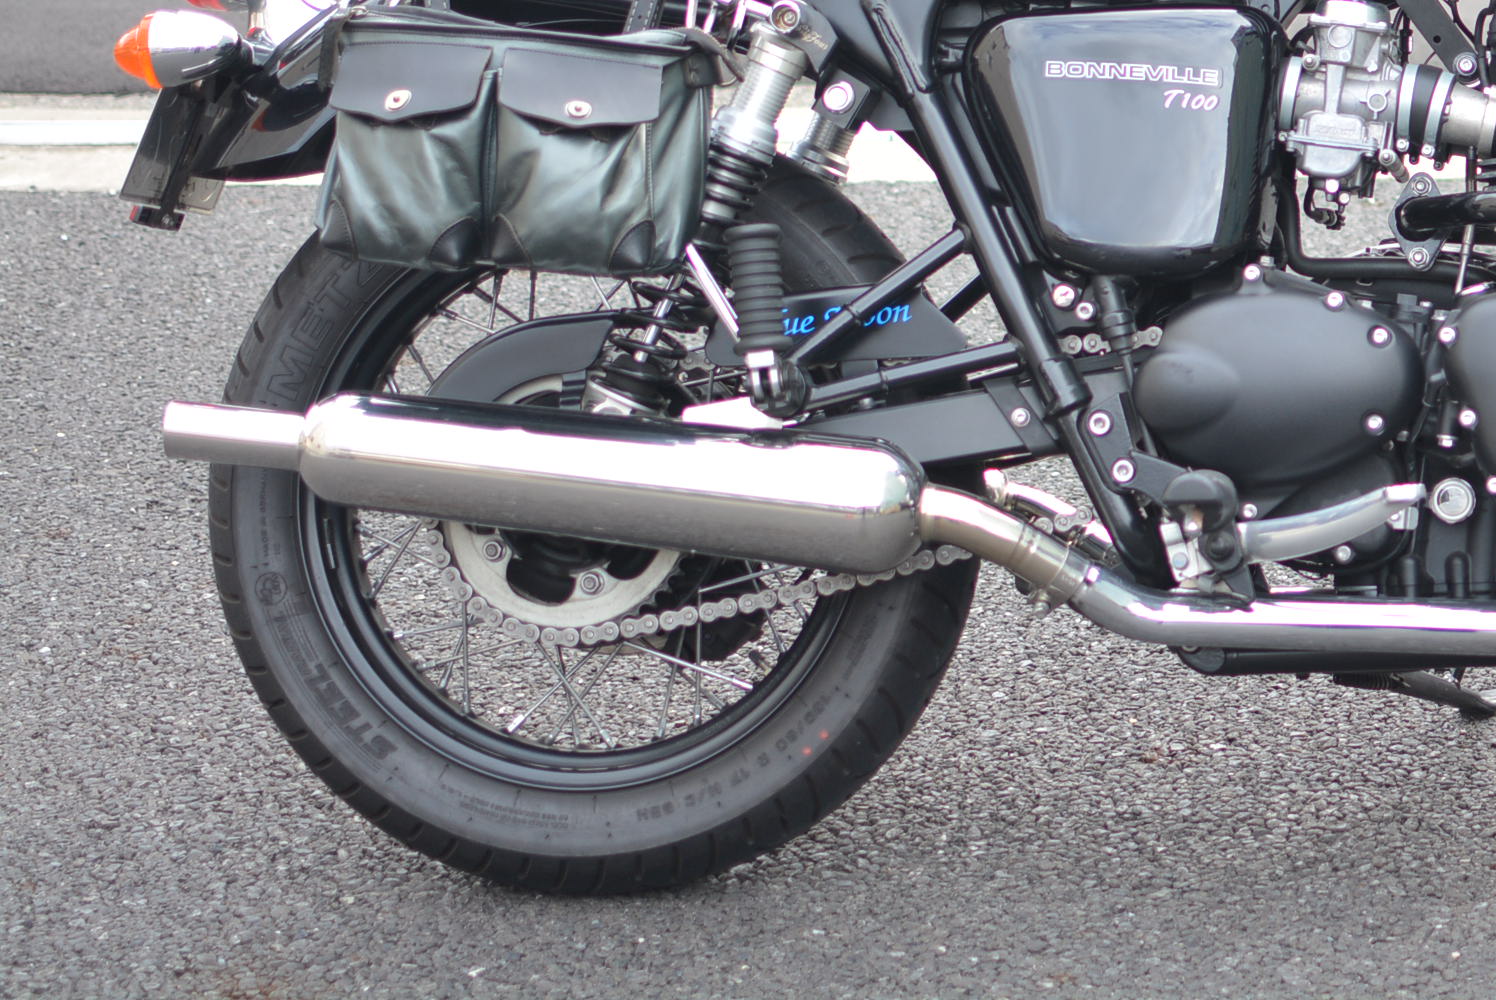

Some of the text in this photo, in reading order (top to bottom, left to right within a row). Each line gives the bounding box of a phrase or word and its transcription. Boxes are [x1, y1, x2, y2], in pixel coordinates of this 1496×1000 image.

[1045, 60, 1219, 86] BONNEVILLE
[1163, 89, 1219, 111] T100
[781, 304, 912, 336] ue on
[299, 660, 398, 767] STEEL
